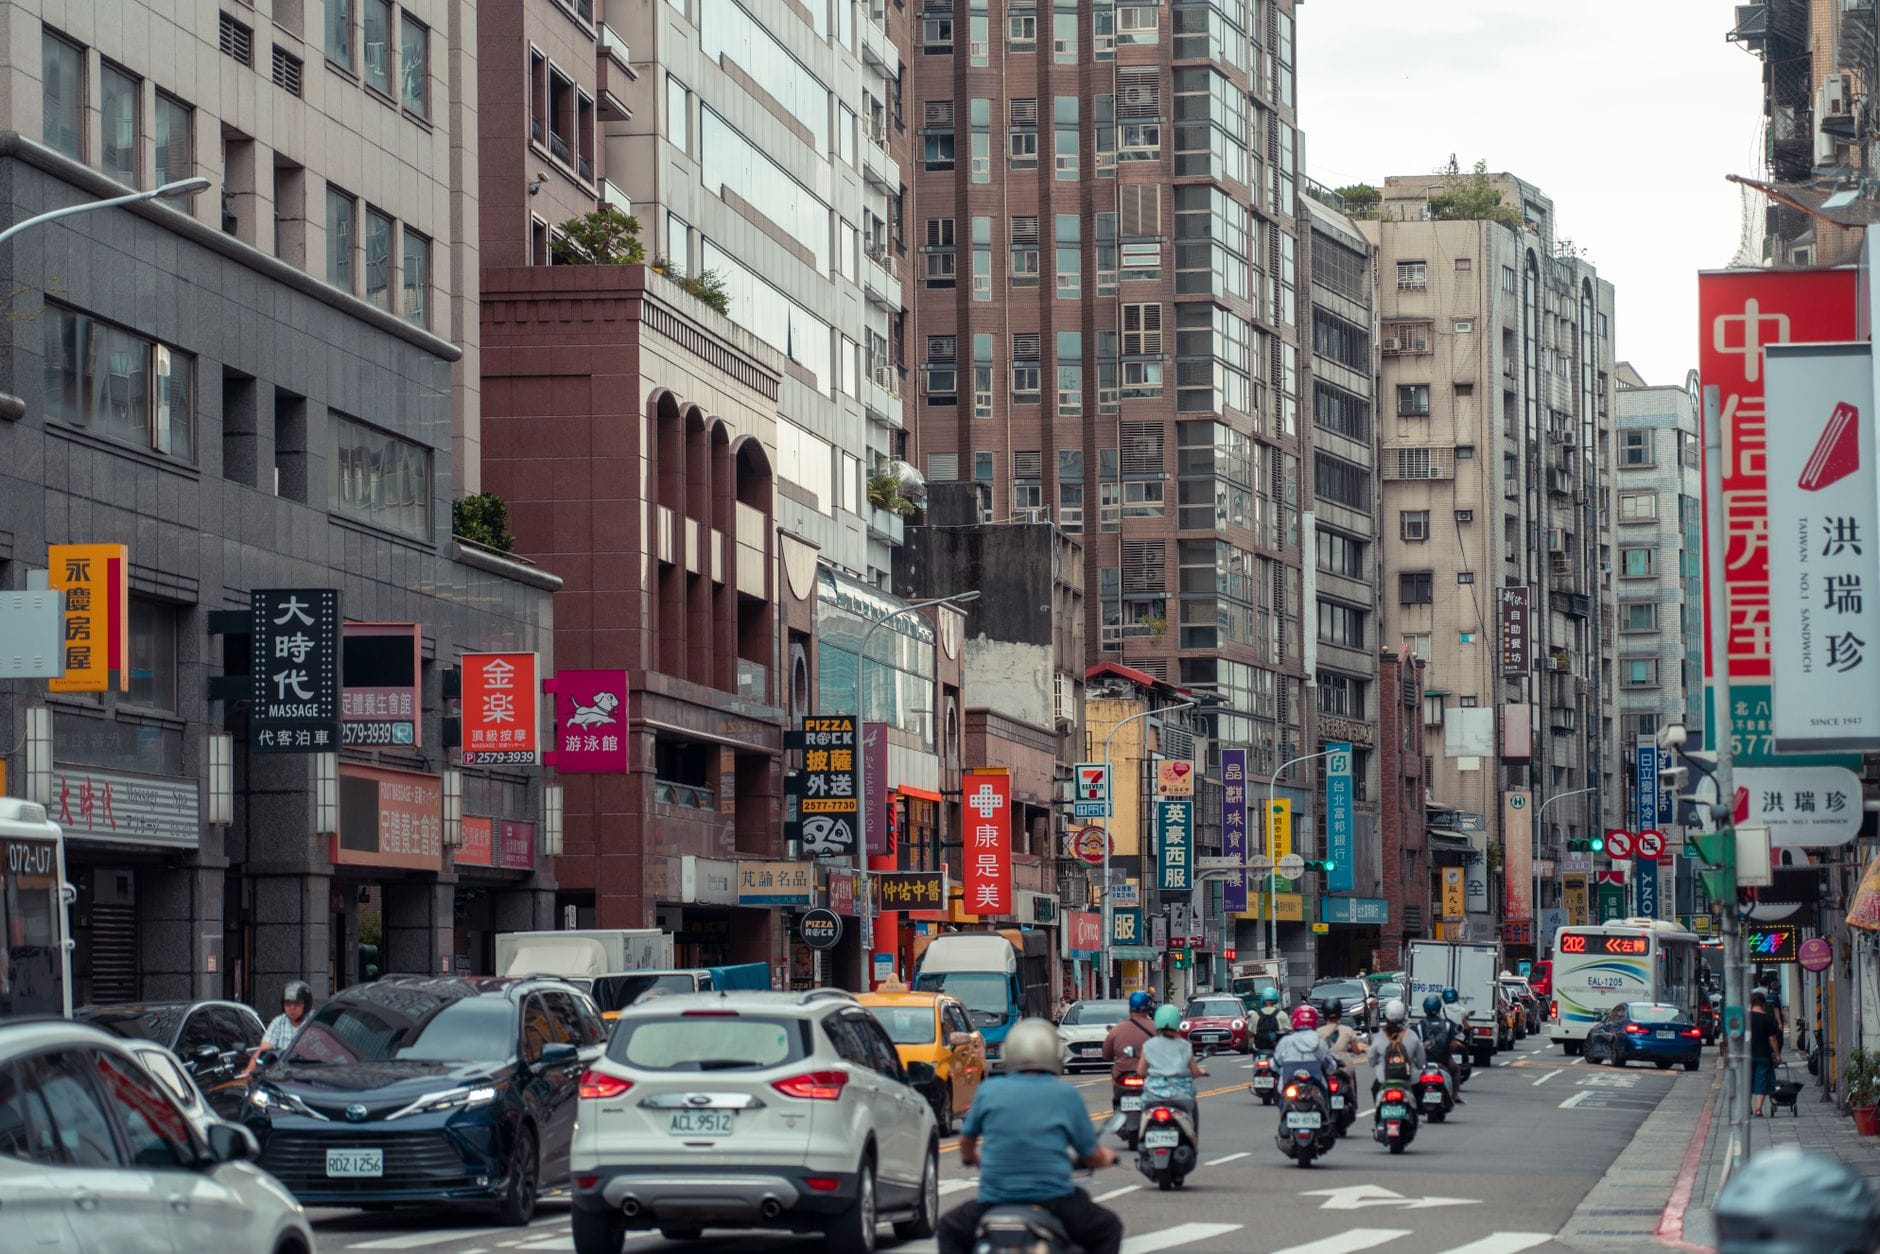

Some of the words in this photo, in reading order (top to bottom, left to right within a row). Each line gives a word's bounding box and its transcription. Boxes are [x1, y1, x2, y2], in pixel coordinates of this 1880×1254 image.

[1799, 517, 1809, 563] TAIWAN
[1800, 573, 1809, 600] NO.1
[1822, 516, 1866, 673] 洪瑞珍
[65, 558, 91, 670] 永慶房屋
[272, 595, 316, 700] 大時代
[1801, 608, 1812, 673] SANDWICH
[482, 658, 515, 723] 金楽
[268, 703, 319, 717] MASSAGE
[805, 719, 853, 731] PIZZA
[1810, 718, 1840, 726] SINCE
[258, 729, 330, 747] 代客泊車
[472, 729, 527, 742] 頂級按摩
[565, 735, 618, 752] 游泳館
[805, 732, 853, 745] ROCK
[476, 751, 534, 763] 2579-3939
[806, 749, 852, 771] 披薩
[807, 773, 852, 796] 外送
[866, 772, 874, 795] HAIR
[59, 775, 116, 831] 大時代
[804, 801, 855, 811] 2577-7730
[1762, 790, 1848, 813] 洪瑞珍
[866, 801, 874, 832] SALON
[1333, 780, 1345, 860] 台北富邦銀行
[1165, 803, 1186, 888] 英豪西服
[975, 824, 1000, 908] 康是美
[883, 879, 941, 901] 仲佑中醫
[1642, 872, 1653, 917] ONY
[805, 919, 834, 928] PIZZA
[805, 928, 834, 937] ROCK
[1114, 913, 1136, 939] 服
[1563, 935, 1585, 952] 202
[1587, 976, 1623, 987] EAL-1205
